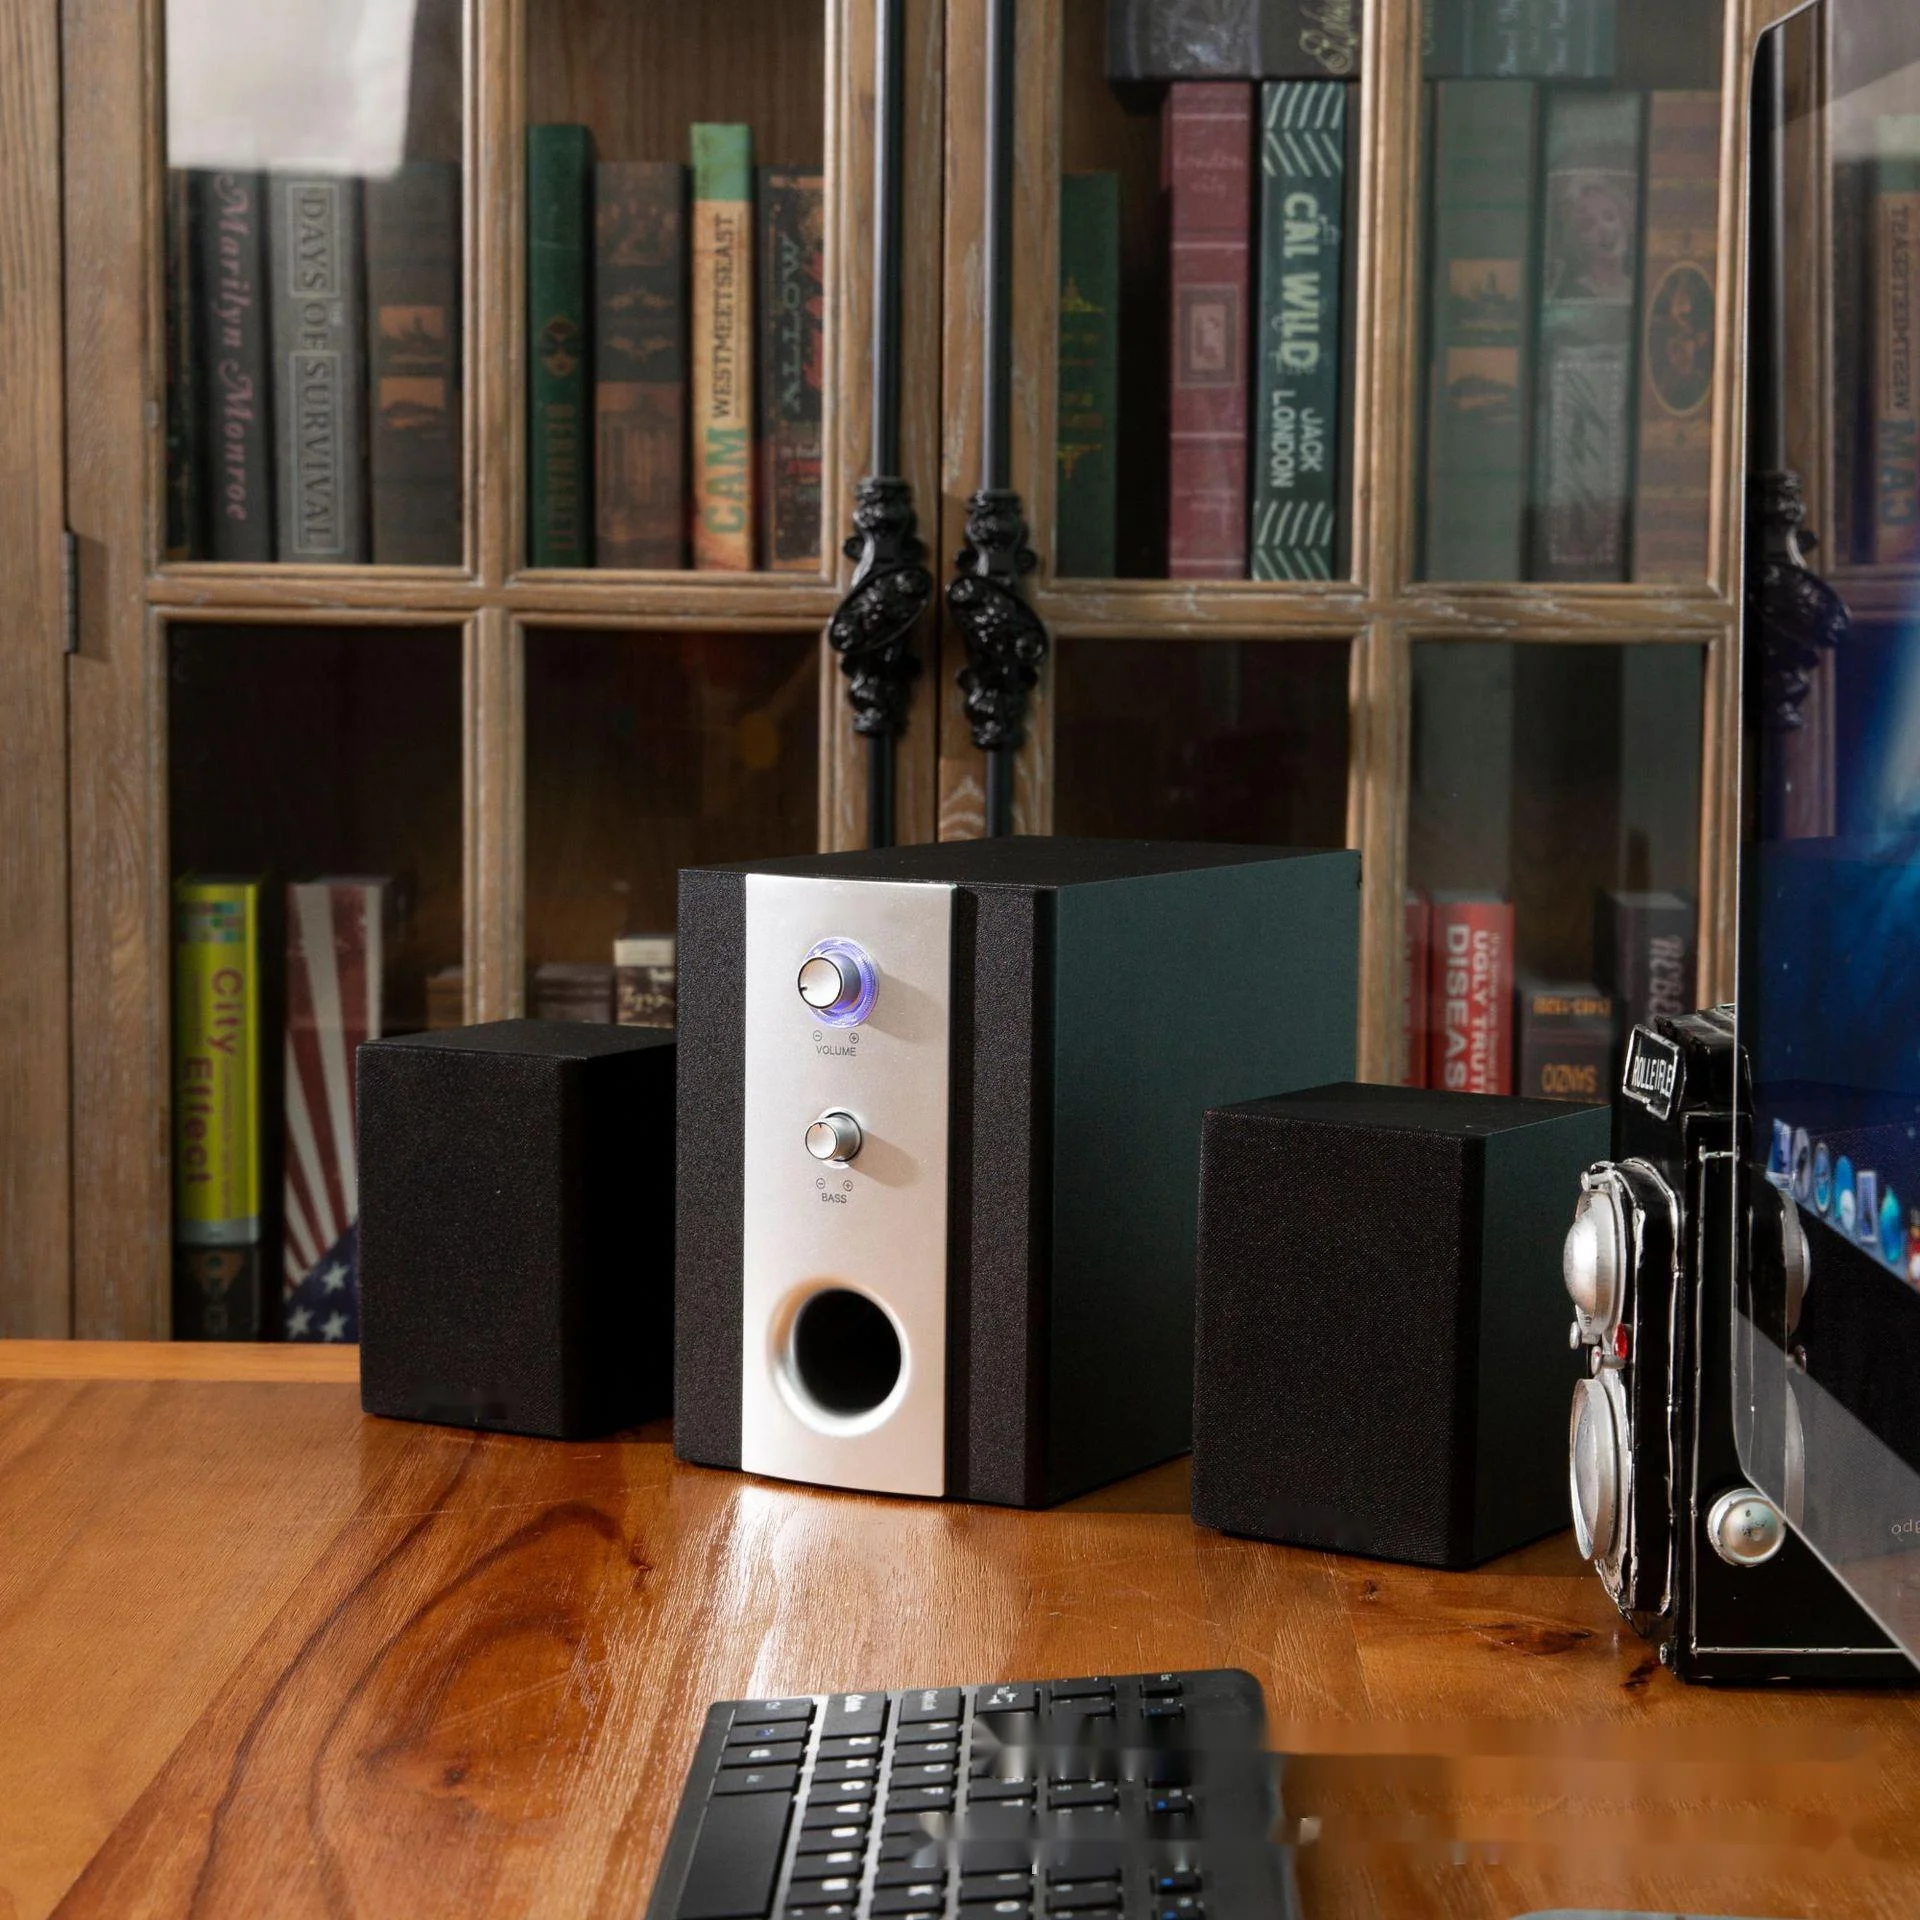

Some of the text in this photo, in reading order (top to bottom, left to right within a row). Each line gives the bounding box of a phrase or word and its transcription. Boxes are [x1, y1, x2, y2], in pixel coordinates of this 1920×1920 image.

[213, 172, 254, 521] Marilyn Monroe
[1281, 271, 1321, 369] WILD
[300, 196, 332, 543] DAYS OF SURVIVAL
[705, 428, 747, 534] CAM
[1270, 389, 1297, 488] LONDON
[1299, 407, 1325, 472] JACK
[208, 967, 244, 1056] City
[1472, 929, 1489, 1006] UGLY
[816, 1045, 857, 1057] VOLUME
[183, 1056, 213, 1185] Effect
[821, 1192, 847, 1204] BASS
